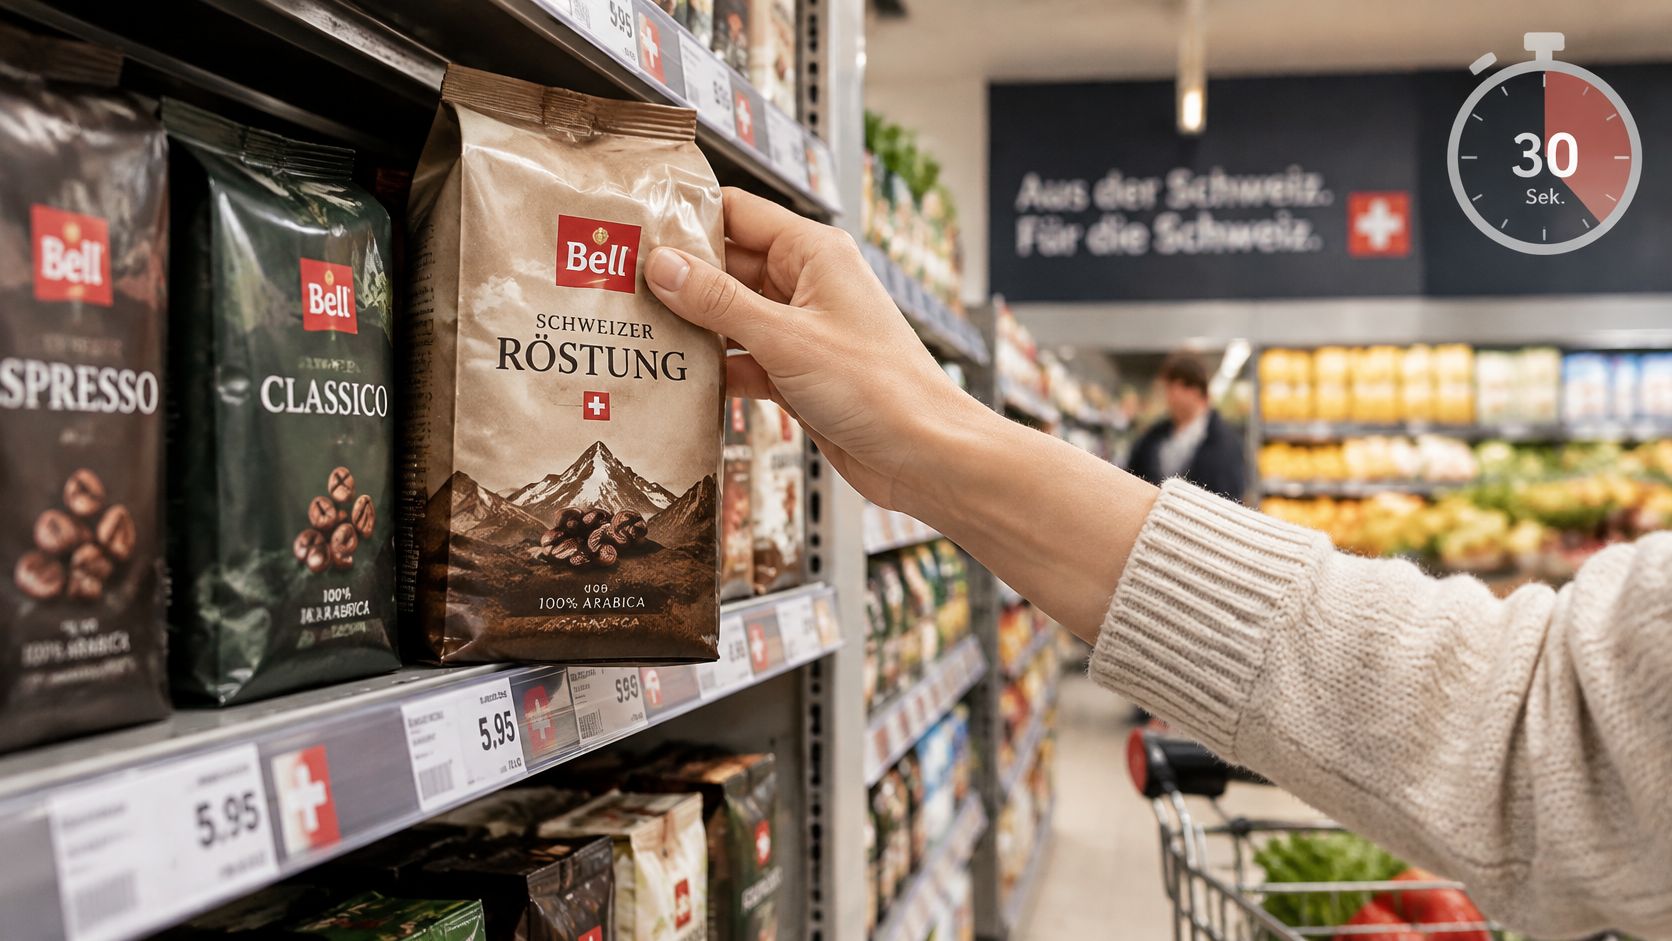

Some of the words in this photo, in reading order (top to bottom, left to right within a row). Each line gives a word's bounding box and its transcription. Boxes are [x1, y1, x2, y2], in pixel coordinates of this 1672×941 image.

[1016, 172, 1088, 211] Aus
[1095, 169, 1160, 210] der
[1166, 167, 1333, 209] Schweiz.
[1016, 213, 1081, 255] Für
[1087, 211, 1150, 255] die
[1154, 211, 1322, 253] Schweiz.
[41, 234, 103, 286] Bell
[566, 241, 629, 277] Bell
[308, 283, 351, 318] Bell
[536, 313, 654, 340] SCHWEIZER
[496, 333, 688, 382] RÖSTUNG
[0, 357, 159, 415] SPRESSO
[261, 375, 388, 417] CLASSICO
[539, 597, 578, 610] 100%
[582, 596, 645, 609] ARABICA
